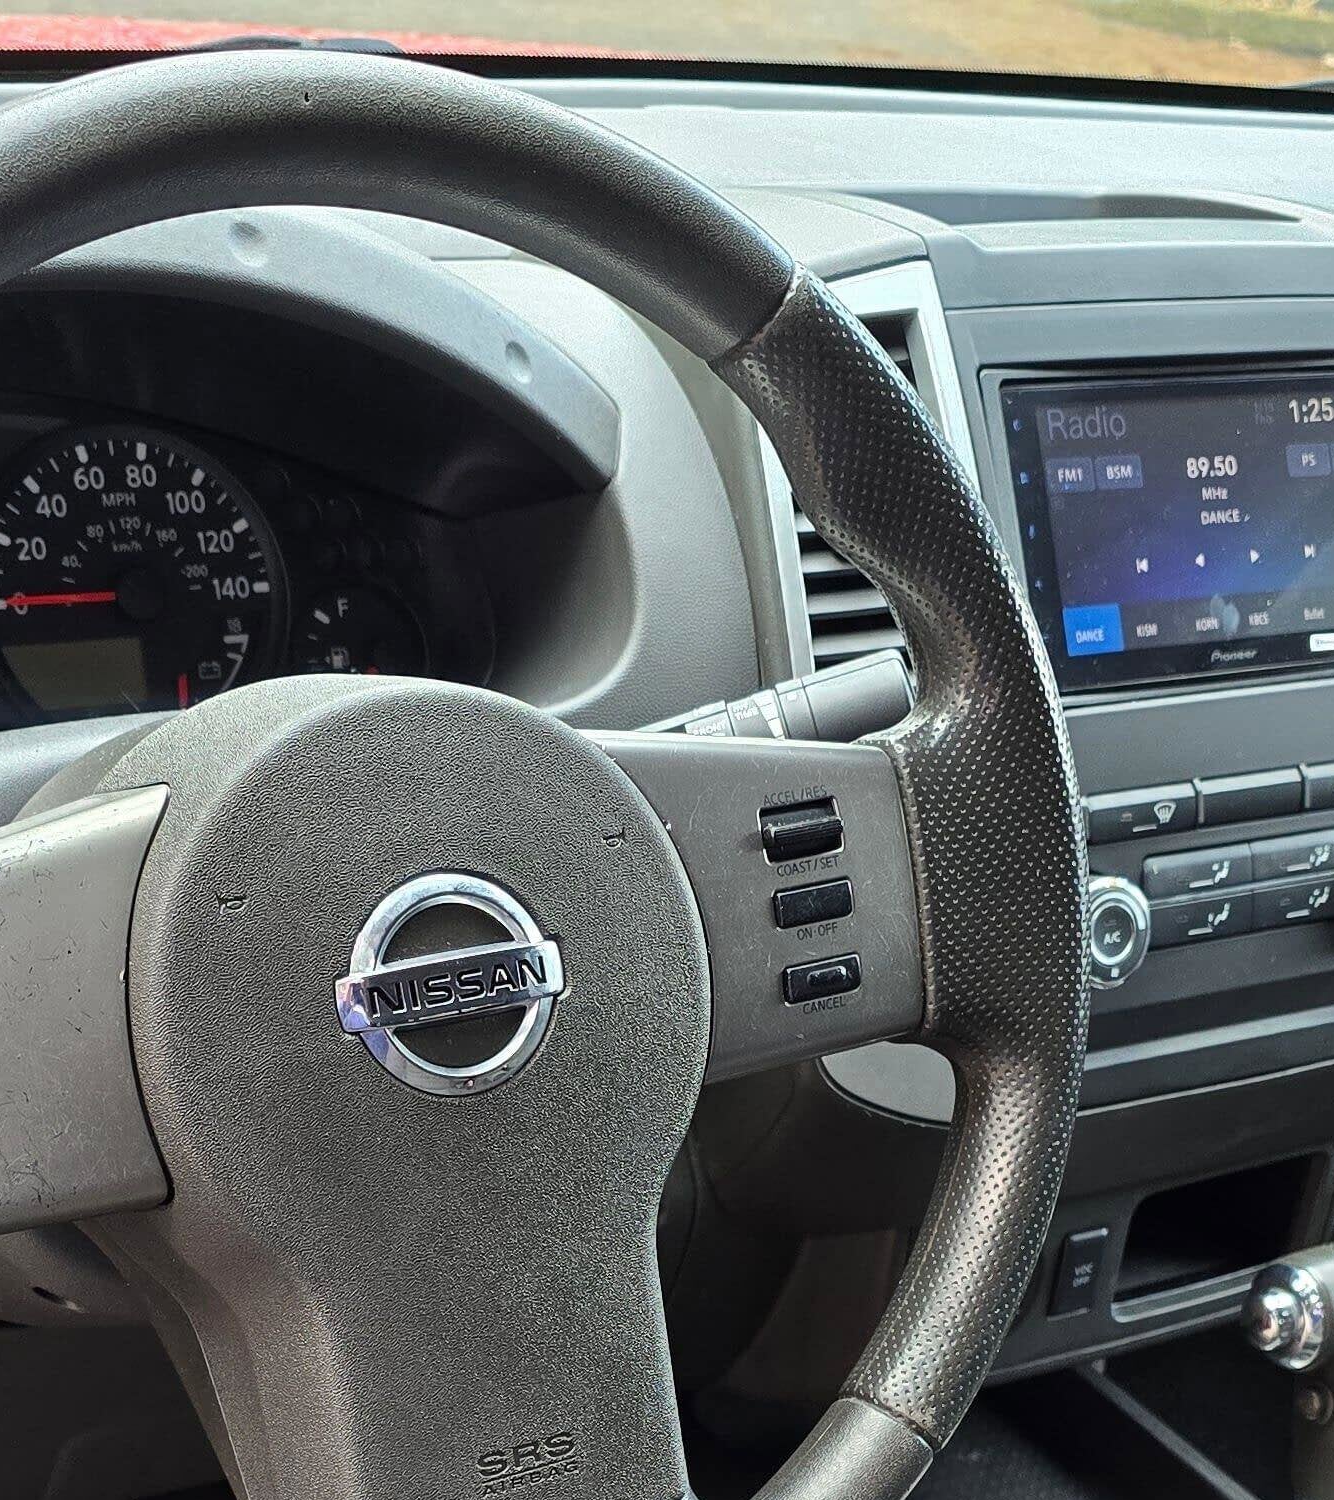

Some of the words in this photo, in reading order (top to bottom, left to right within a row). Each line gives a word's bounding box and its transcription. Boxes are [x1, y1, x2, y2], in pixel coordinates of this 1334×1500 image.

[1047, 407, 1127, 441] Radio
[73, 465, 106, 491] 60
[125, 463, 157, 488] 80
[1185, 455, 1239, 479] 89.50
[35, 493, 67, 519] 40
[101, 491, 137, 508] MPH
[165, 490, 206, 515] 100
[1200, 509, 1241, 526] DANCE
[15, 536, 47, 562] 20
[197, 529, 235, 555] 120
[212, 575, 250, 601] 140
[336, 596, 349, 618] F
[1074, 627, 1106, 645] DANCE
[1210, 648, 1259, 664] Pioneer
[764, 784, 828, 806] ACCEL/RES
[776, 855, 840, 877] COAST/SET
[1103, 931, 1122, 945] A/C
[369, 956, 547, 1019] NISSAN
[802, 996, 847, 1015] CANCEL
[477, 1431, 576, 1479] SRS
